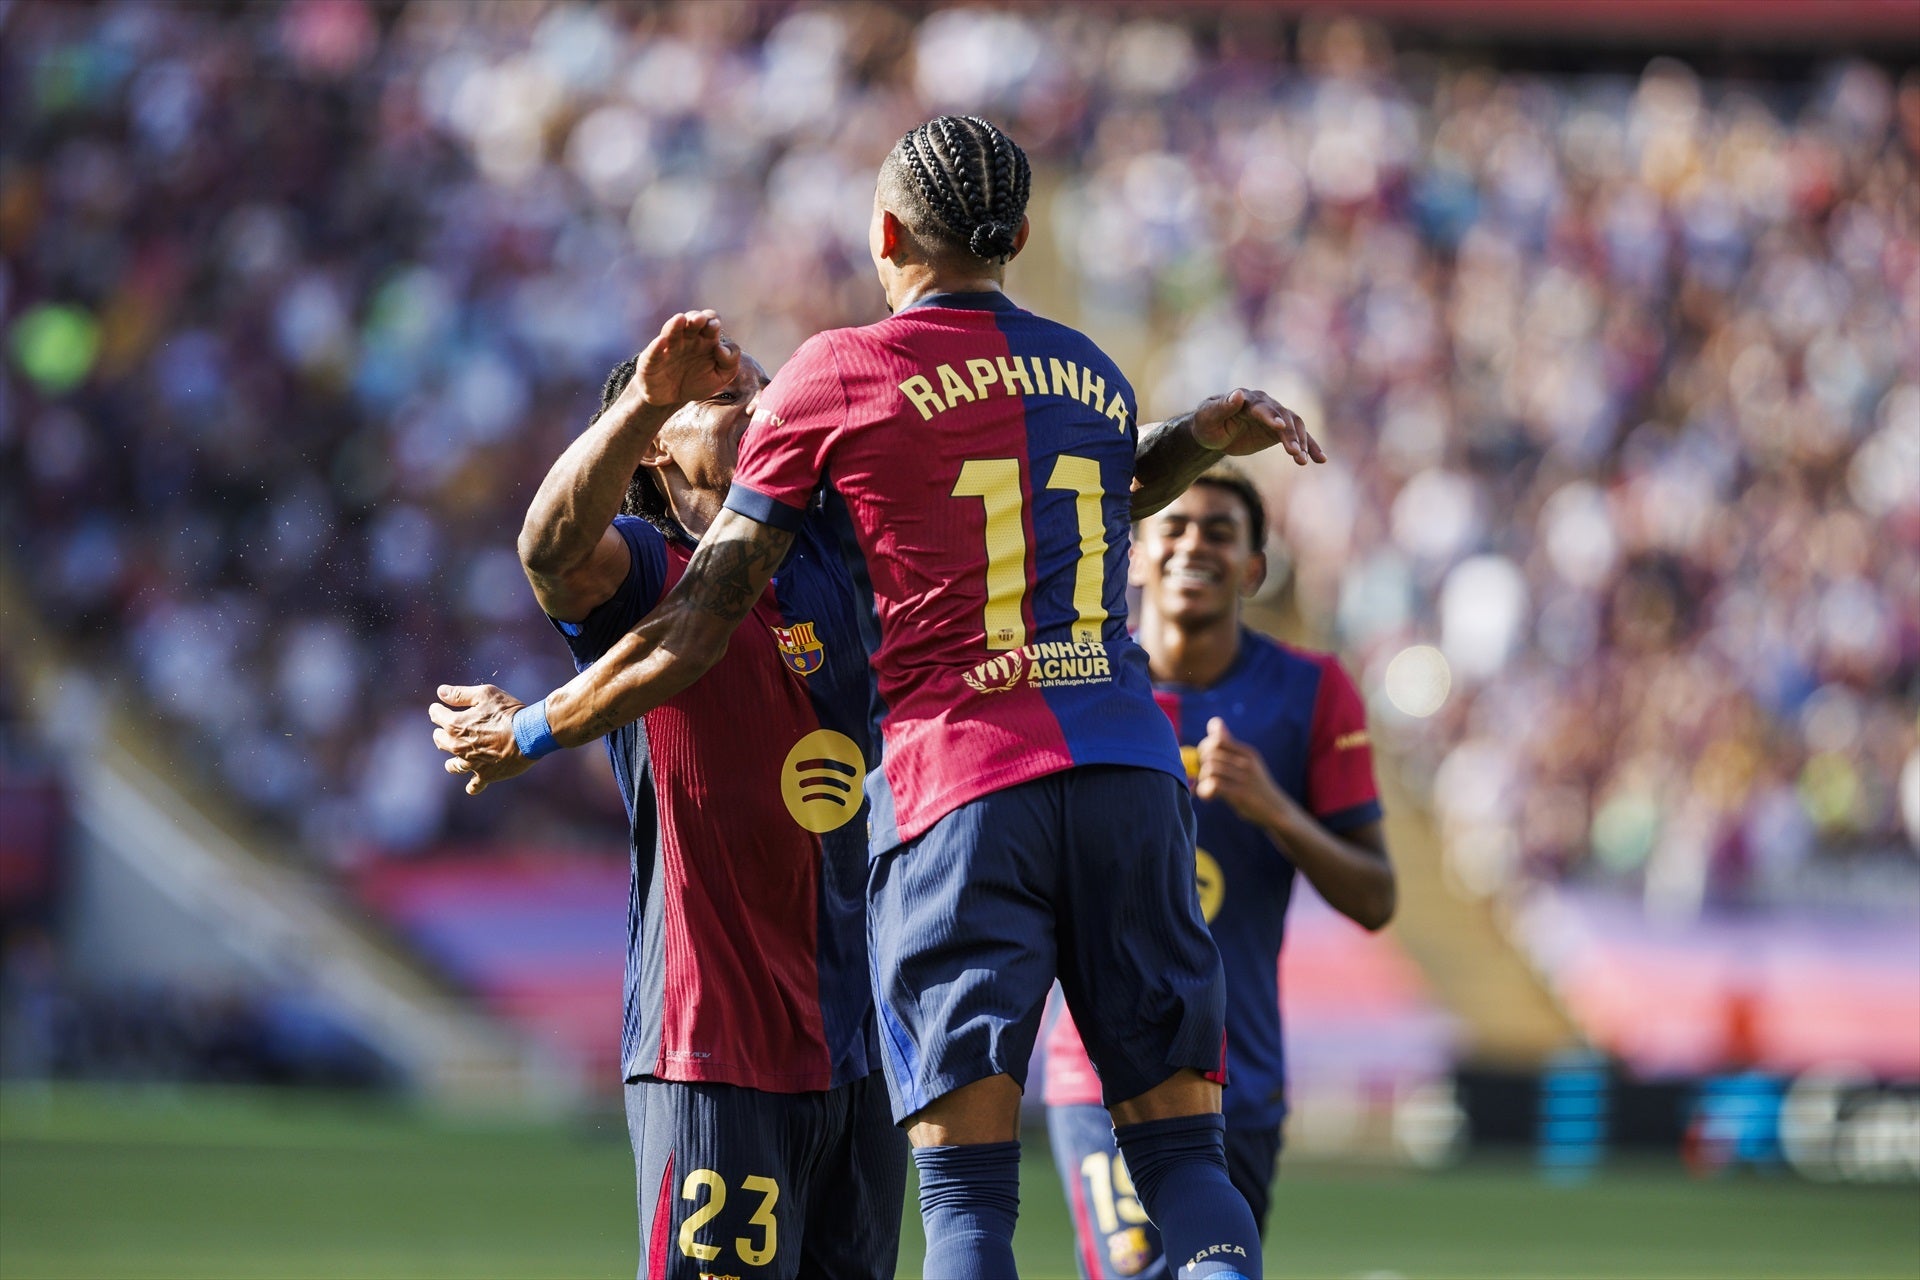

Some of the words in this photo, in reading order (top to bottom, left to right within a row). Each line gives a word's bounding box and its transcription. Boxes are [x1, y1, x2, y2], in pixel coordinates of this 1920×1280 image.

[898, 355, 1129, 435] RAPHINHA
[950, 454, 1109, 650] 11
[1022, 641, 1108, 660] UNHCR
[1027, 657, 1111, 680] ACNUR
[1055, 678, 1085, 686] Refugee
[678, 1168, 780, 1266] 23
